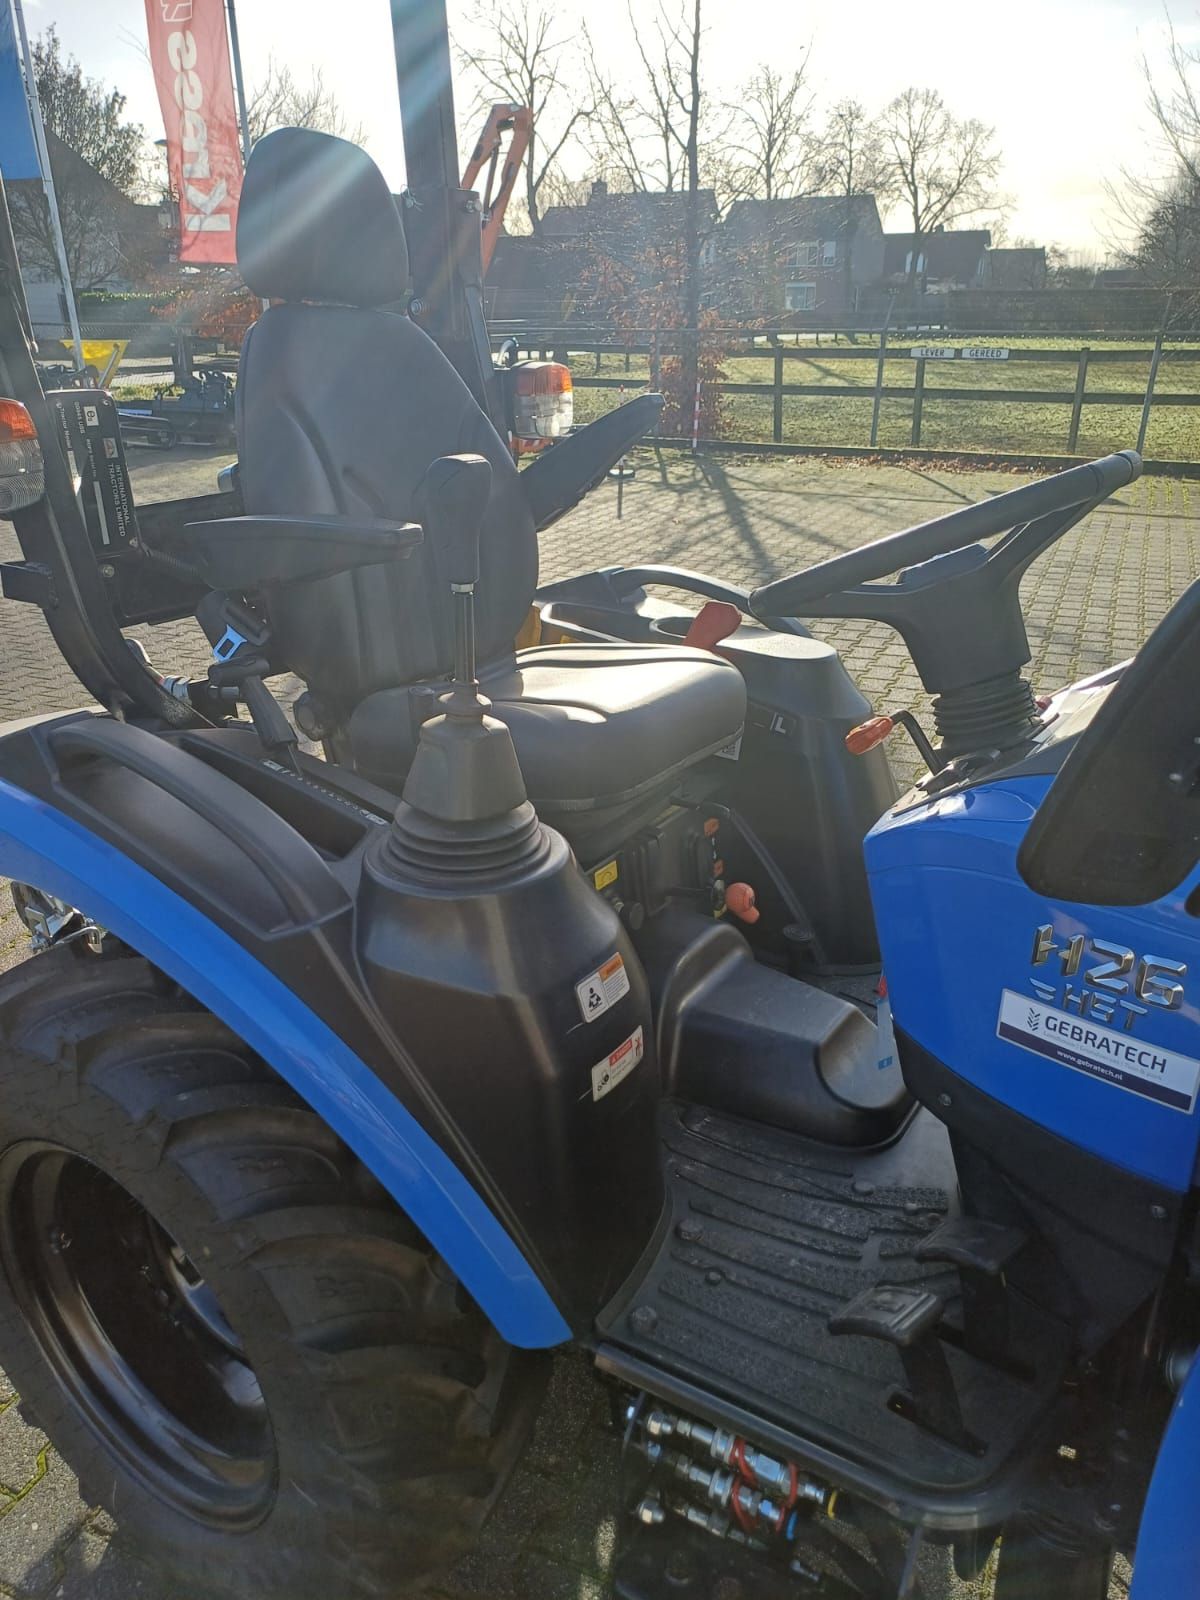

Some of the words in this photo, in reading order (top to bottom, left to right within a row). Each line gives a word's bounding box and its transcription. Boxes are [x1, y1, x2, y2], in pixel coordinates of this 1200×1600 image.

[920, 349, 945, 357] LEVER
[969, 349, 1002, 358] GEREED
[107, 463, 120, 505] TRACTORS
[115, 506, 126, 537] LIMITED
[115, 464, 130, 526] INTERNATIONAL
[1031, 923, 1187, 1011] H26
[1062, 983, 1148, 1031] HST
[1045, 1015, 1167, 1074] GEBRATECH
[1056, 1049, 1123, 1081] www.gebratech.nl
